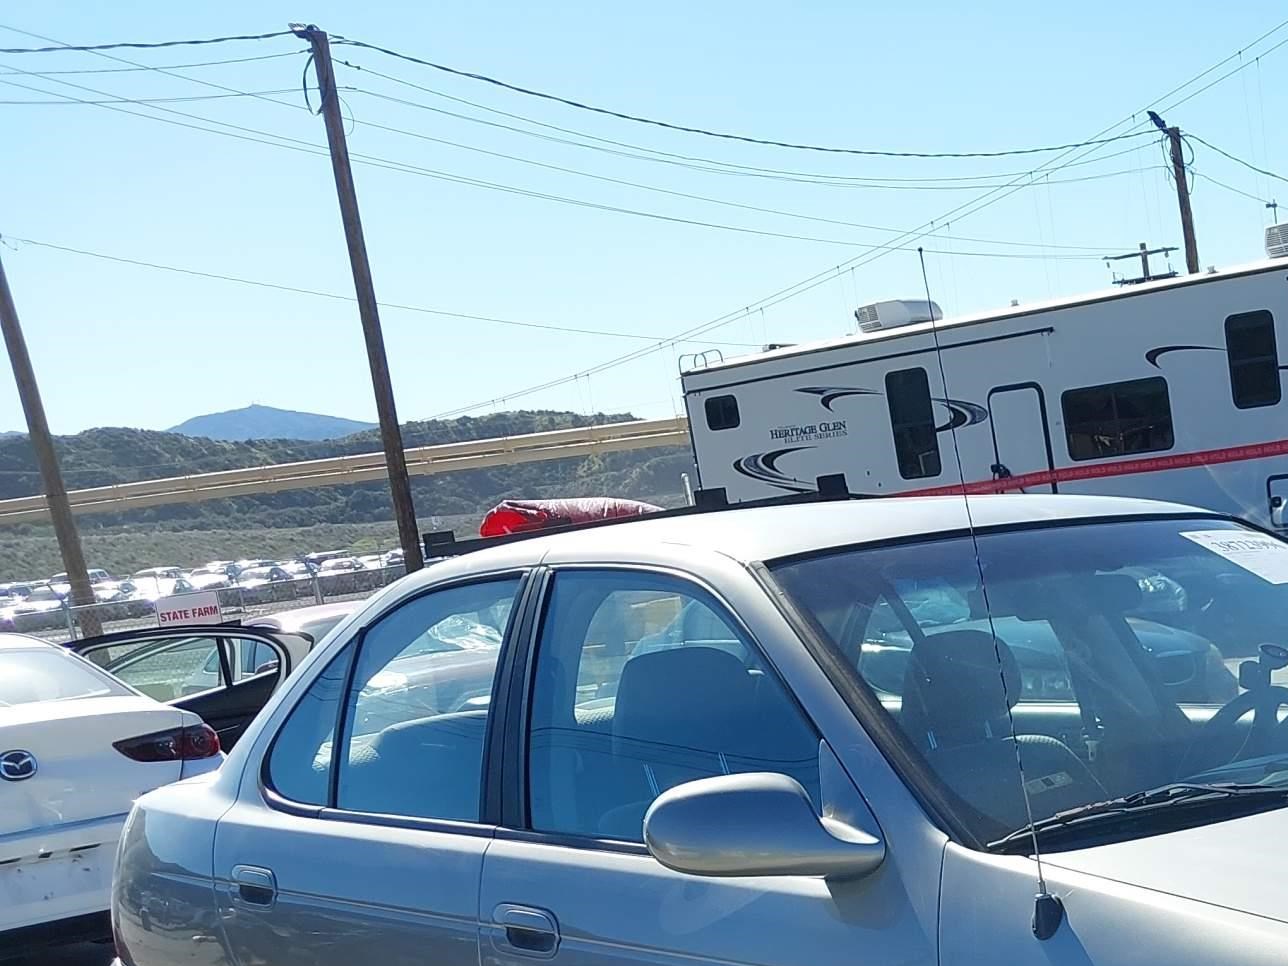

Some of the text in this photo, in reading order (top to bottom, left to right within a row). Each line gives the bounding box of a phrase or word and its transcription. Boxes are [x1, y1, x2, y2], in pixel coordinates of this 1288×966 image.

[769, 420, 847, 440] HERITAGE GLEN
[160, 605, 218, 622] STATE FARM
